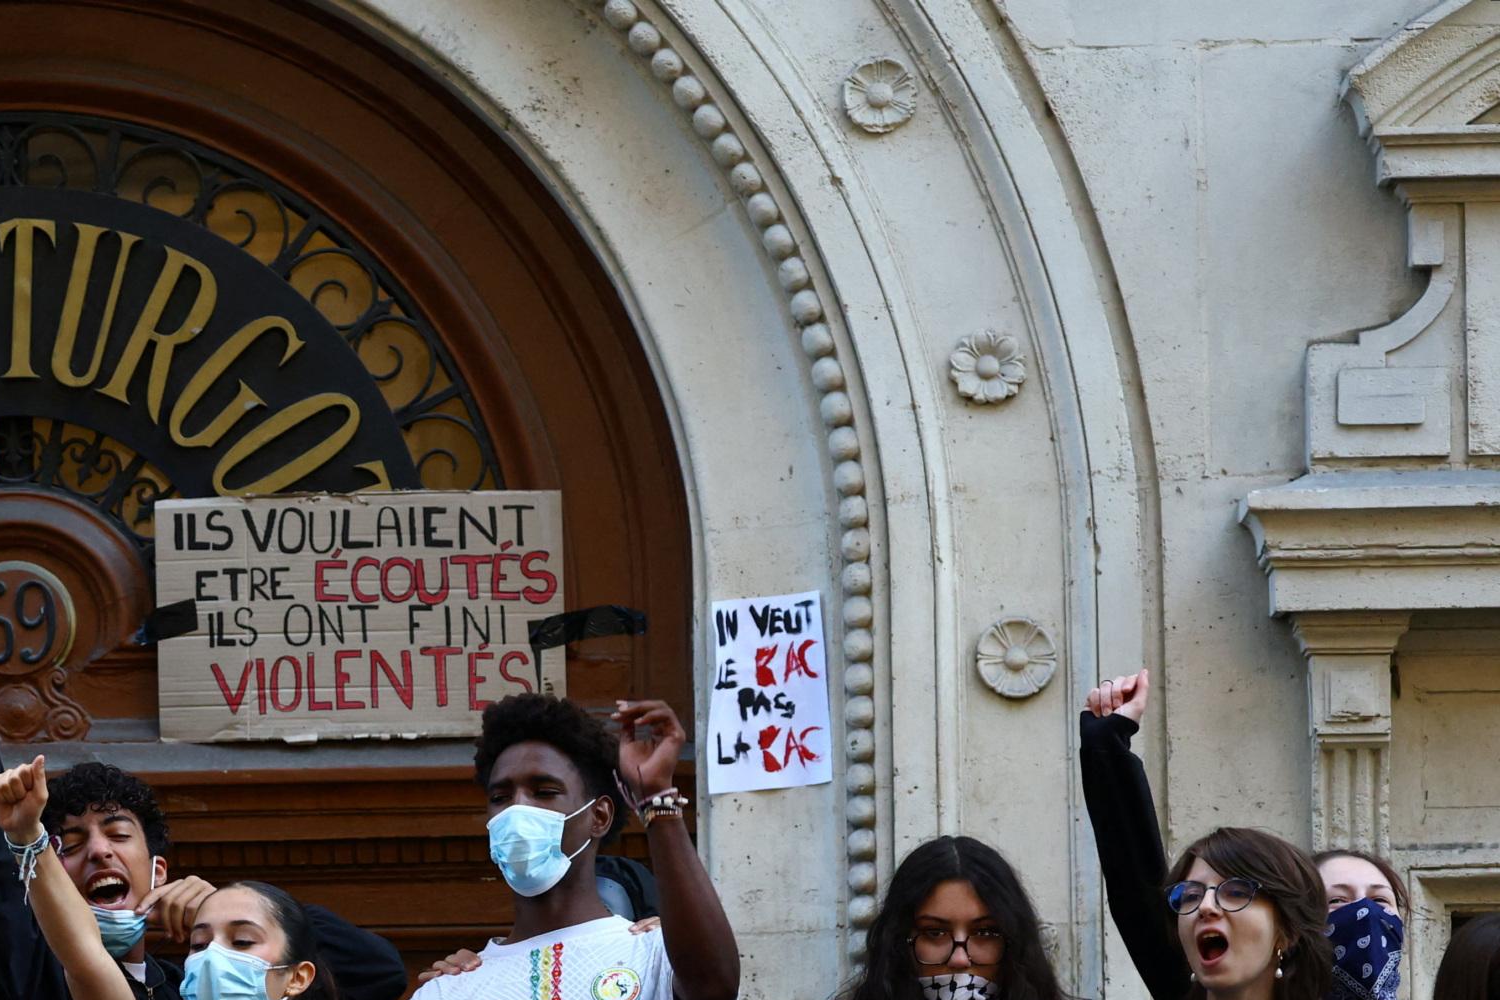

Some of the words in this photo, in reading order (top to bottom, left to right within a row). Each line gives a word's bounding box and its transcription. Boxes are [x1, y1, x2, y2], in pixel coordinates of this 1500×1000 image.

[174, 509, 234, 552] ILS
[242, 504, 535, 554] VOULAIENT
[195, 566, 295, 602] ETRE
[314, 540, 558, 605] ÉCOUTÉS
[208, 606, 259, 648] ILS
[283, 603, 379, 646] ONT
[409, 603, 506, 646] FINI
[749, 599, 815, 638] VEUT
[210, 642, 533, 717] VIOLENTÉS
[715, 658, 738, 690] LE
[737, 687, 796, 721] PAS
[717, 731, 752, 765] LA
